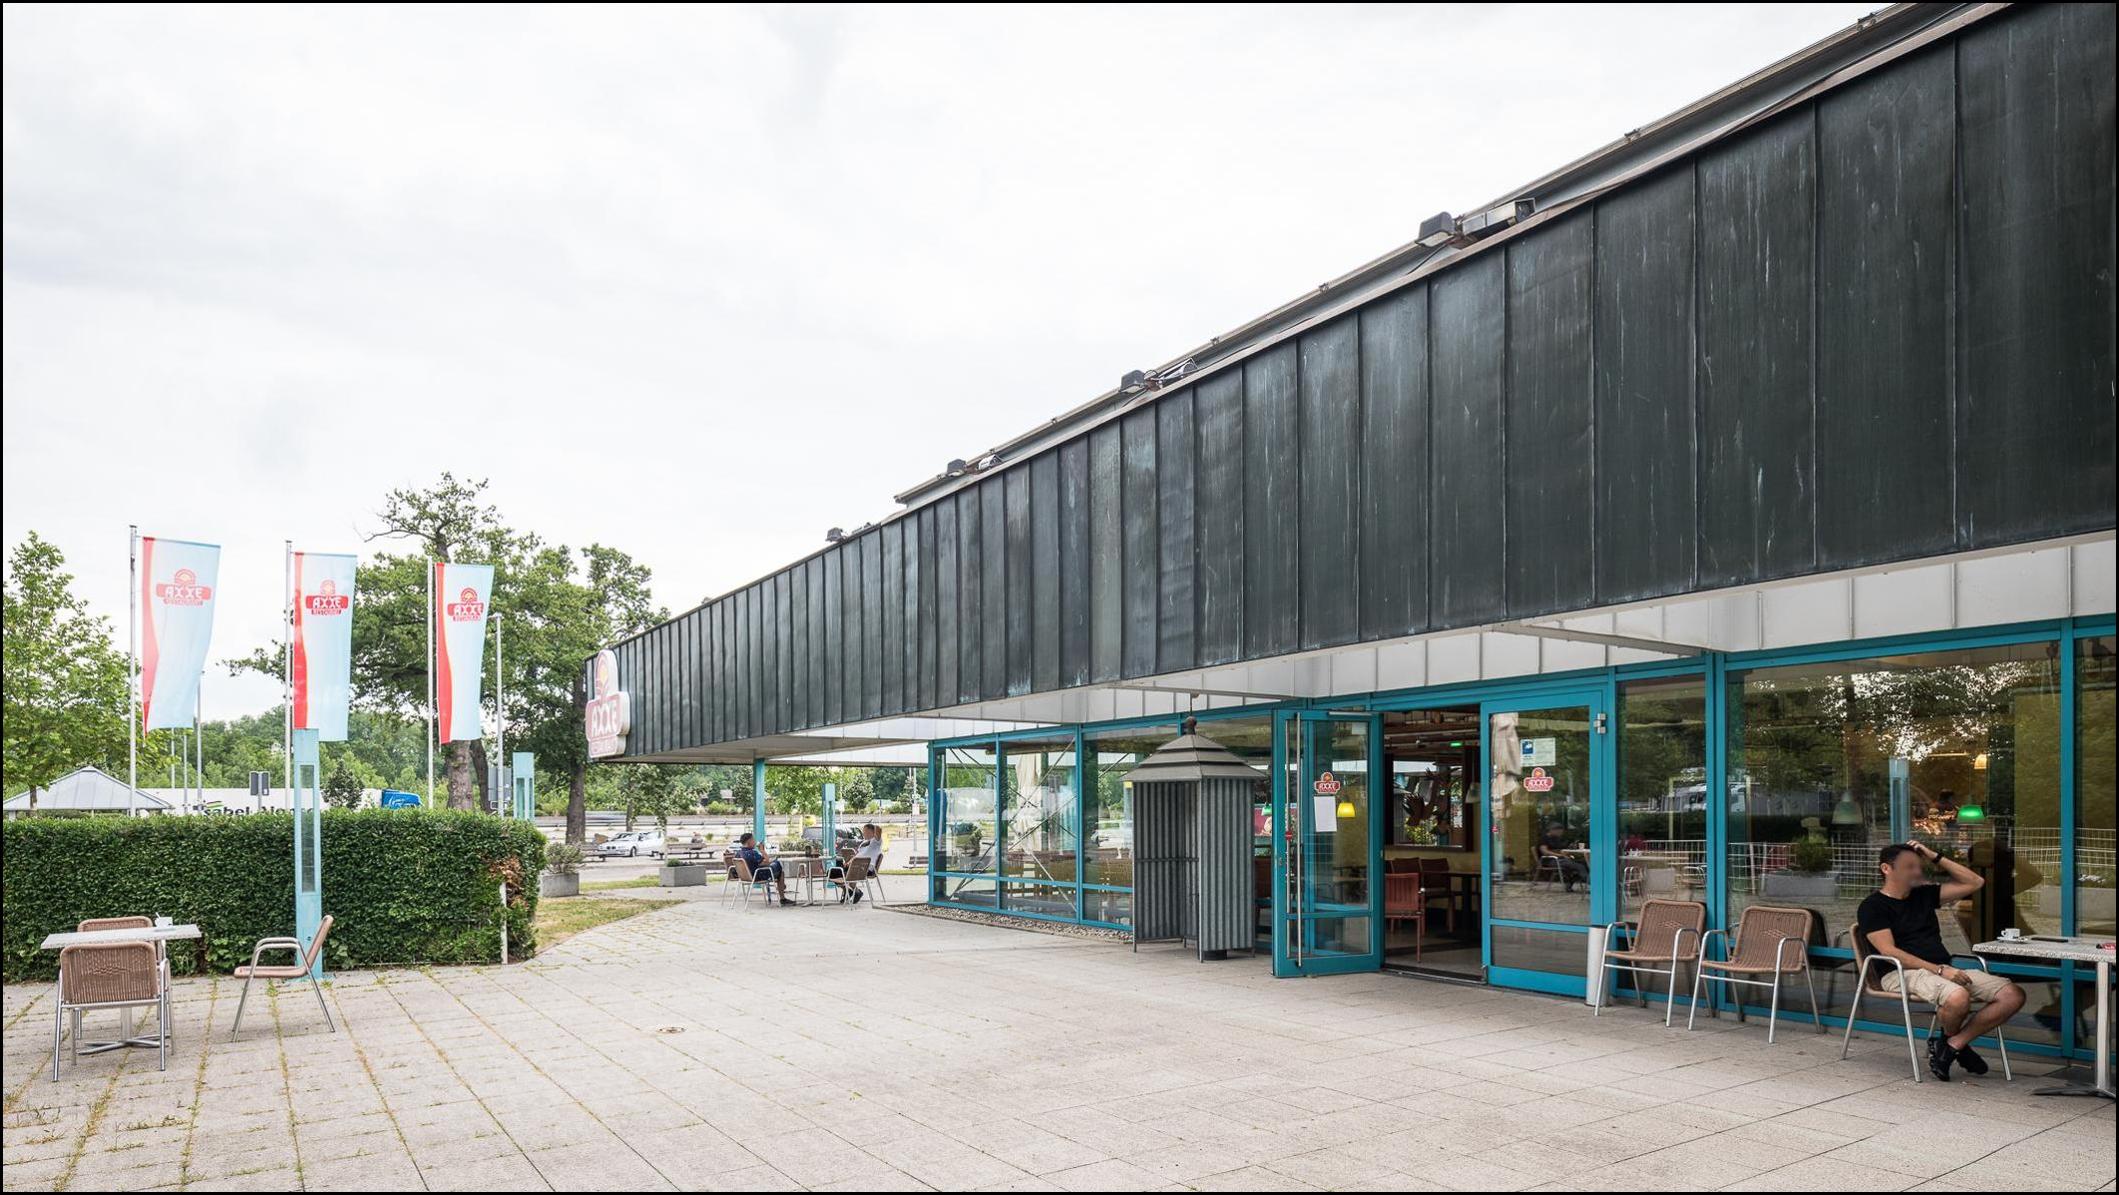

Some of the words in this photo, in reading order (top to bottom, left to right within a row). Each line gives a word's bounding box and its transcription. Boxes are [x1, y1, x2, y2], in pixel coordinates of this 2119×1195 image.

[164, 586, 203, 600] AXXE
[312, 597, 342, 609] AXXE
[592, 700, 619, 737] AXXE
